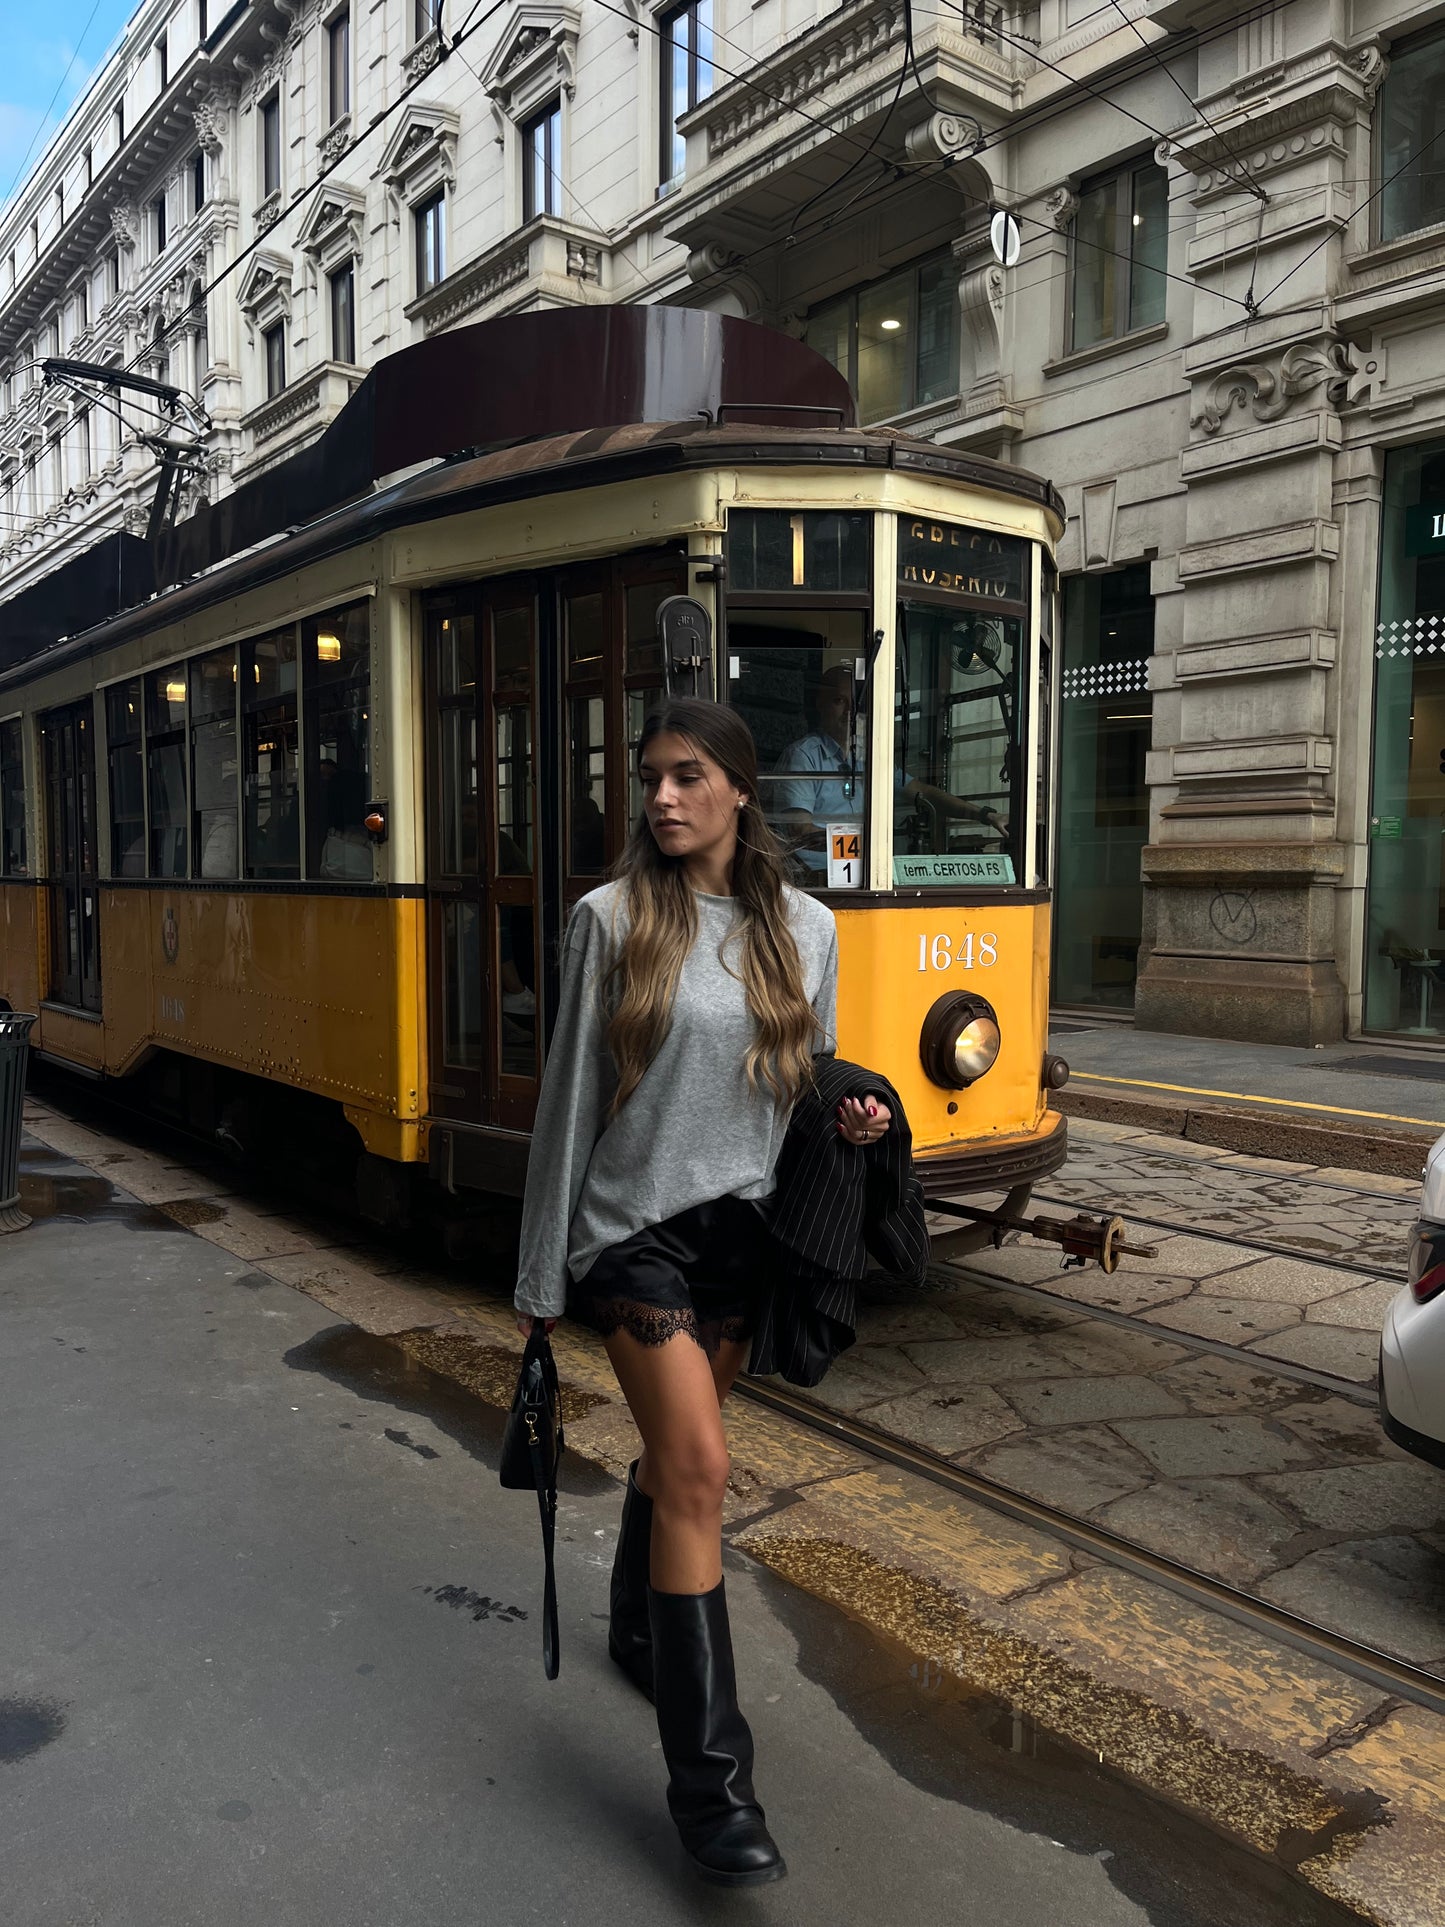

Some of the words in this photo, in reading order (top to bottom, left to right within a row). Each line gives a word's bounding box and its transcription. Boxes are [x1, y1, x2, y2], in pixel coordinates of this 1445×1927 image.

[789, 513, 804, 585] 1
[836, 836, 860, 858] 14
[842, 862, 852, 884] 1
[903, 864, 932, 878] term.
[933, 862, 985, 877] CERTOSA
[986, 862, 1001, 876] FS
[918, 932, 998, 972] 1648
